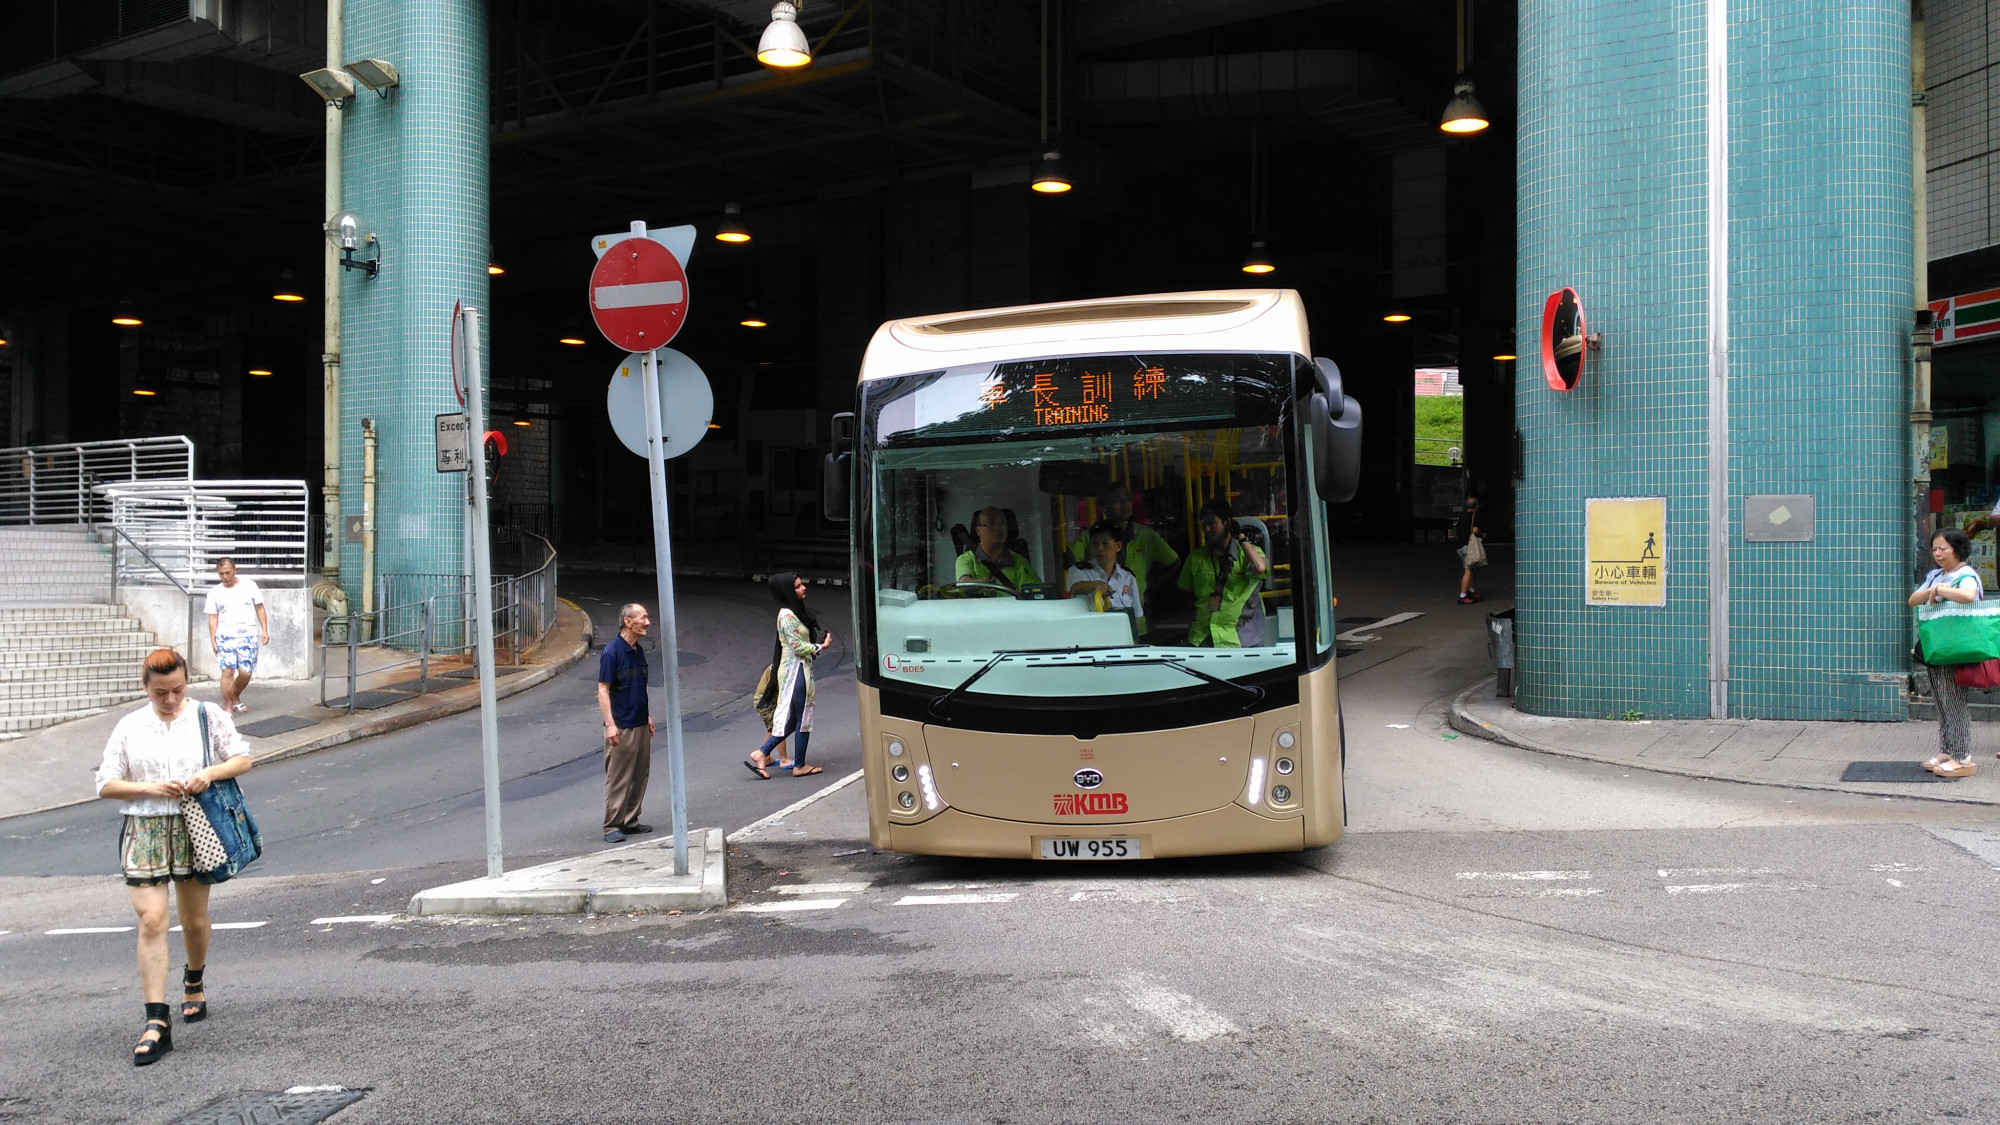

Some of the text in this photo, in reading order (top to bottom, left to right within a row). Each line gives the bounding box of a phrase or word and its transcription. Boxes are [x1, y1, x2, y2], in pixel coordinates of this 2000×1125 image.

[1928, 300, 1950, 342] 7
[1033, 404, 1109, 426] TRAINING
[1595, 565, 1656, 580] 小心車輛
[902, 665, 925, 673] BDE5
[1076, 774, 1101, 784] BYD
[1075, 793, 1129, 815] KMB
[1053, 840, 1128, 857] UW 955
